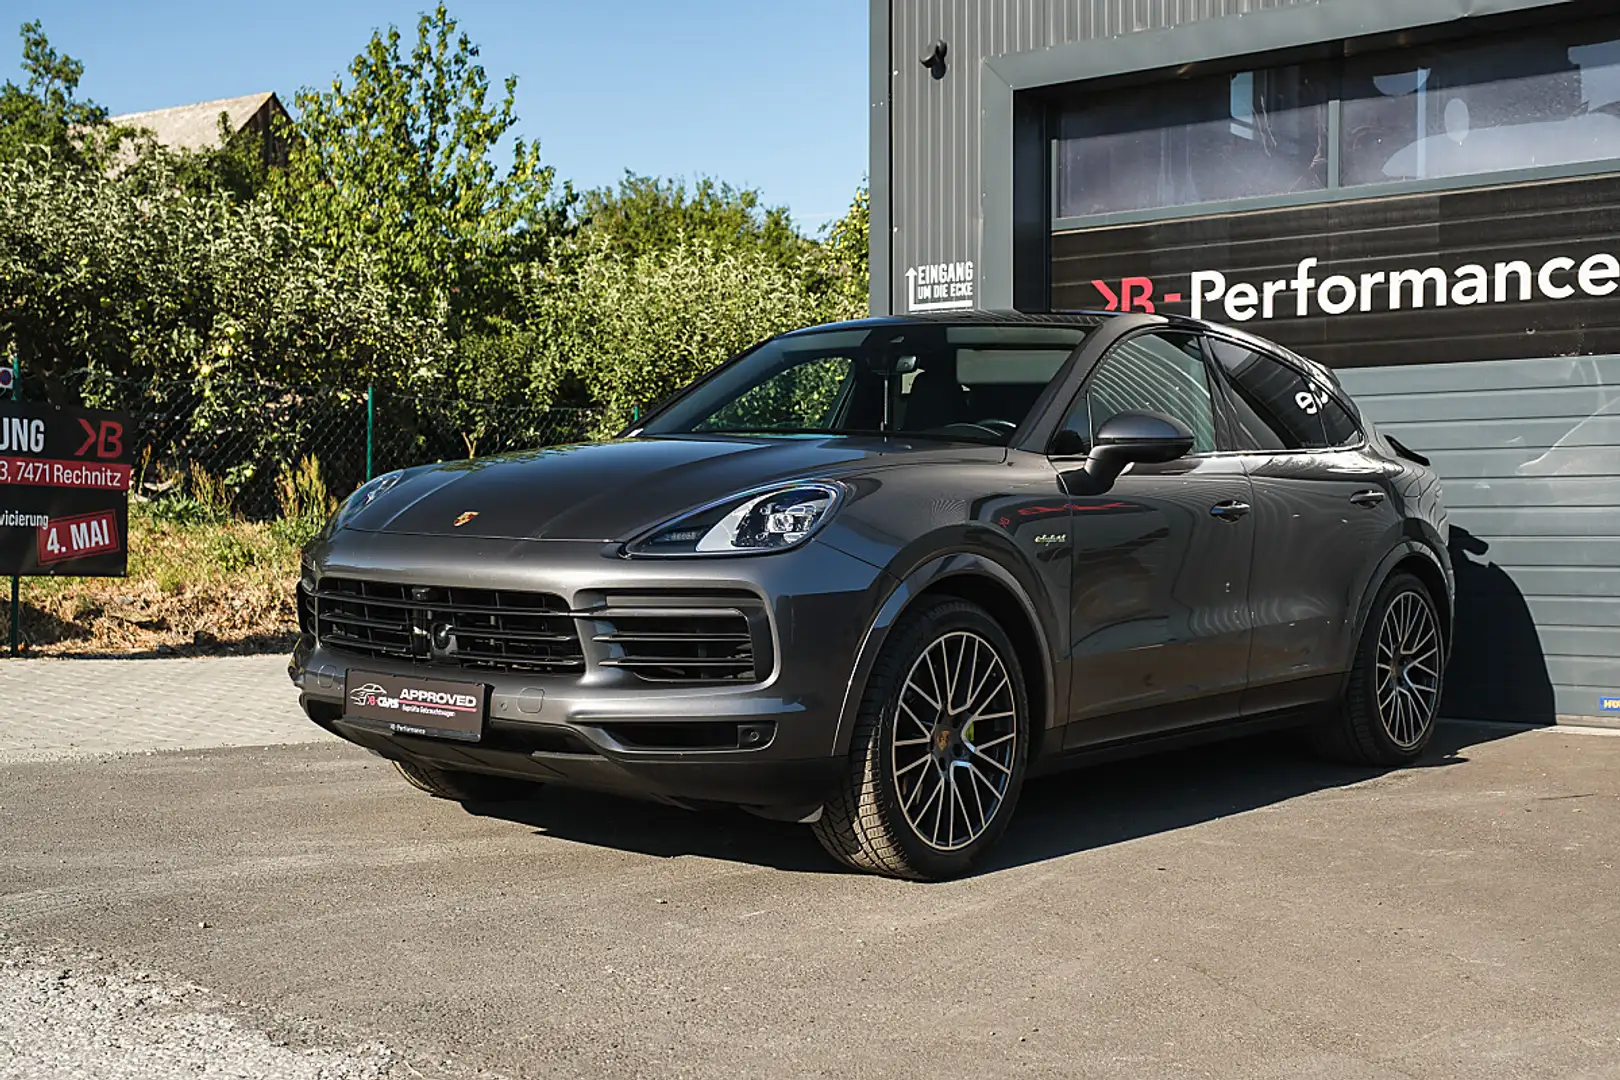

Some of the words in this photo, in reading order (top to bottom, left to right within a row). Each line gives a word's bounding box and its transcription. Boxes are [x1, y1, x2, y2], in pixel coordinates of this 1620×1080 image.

[918, 261, 973, 284] EINGANG
[918, 285, 931, 299] UM
[933, 284, 949, 298] DIE
[950, 282, 974, 297] ECKE
[16, 461, 50, 483] 7471
[54, 464, 121, 486] Rechnitz
[46, 528, 67, 554] 4.
[70, 519, 110, 551] MAI
[399, 688, 477, 707] APPROVED
